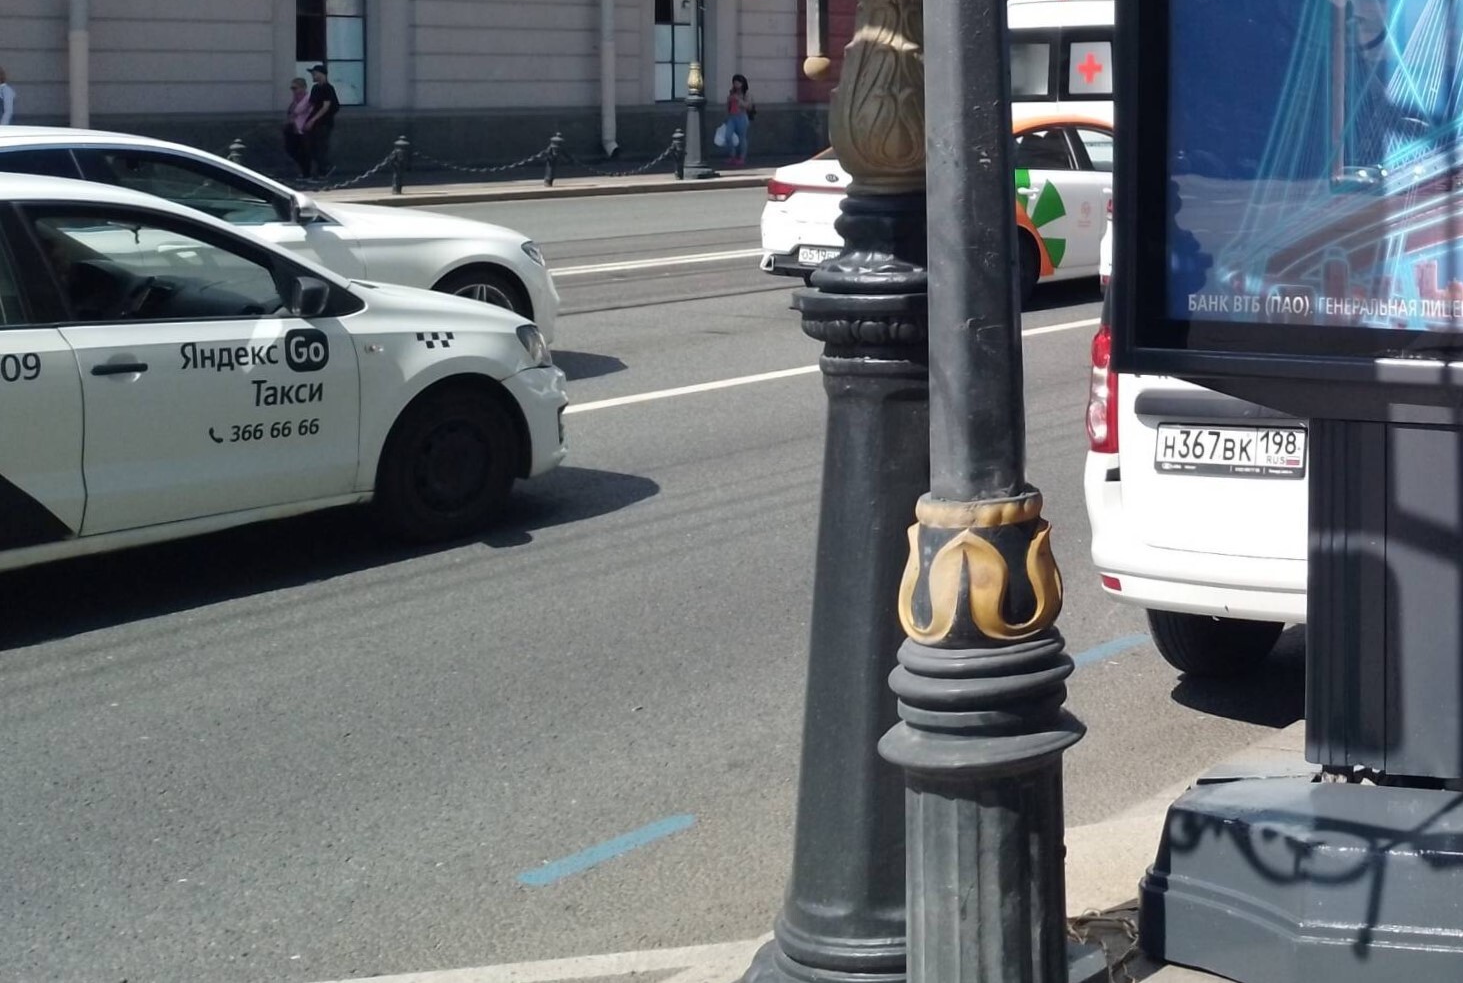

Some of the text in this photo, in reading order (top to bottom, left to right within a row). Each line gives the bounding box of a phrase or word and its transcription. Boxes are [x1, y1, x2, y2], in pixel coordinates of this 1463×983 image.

[1188, 294, 1230, 312] БАНК
[1233, 295, 1261, 313] ВТБ
[1264, 293, 1314, 317] (ПАО).
[1318, 297, 1417, 317] ГЕНЕРАЛЬНАЯ
[180, 335, 326, 372] Яндекс Go
[0, 353, 42, 383] 09
[252, 379, 324, 407] Такси
[229, 418, 320, 443] 366 66 66
[1163, 430, 1297, 462] Н367ВК 198
[1266, 455, 1286, 465] RUS
